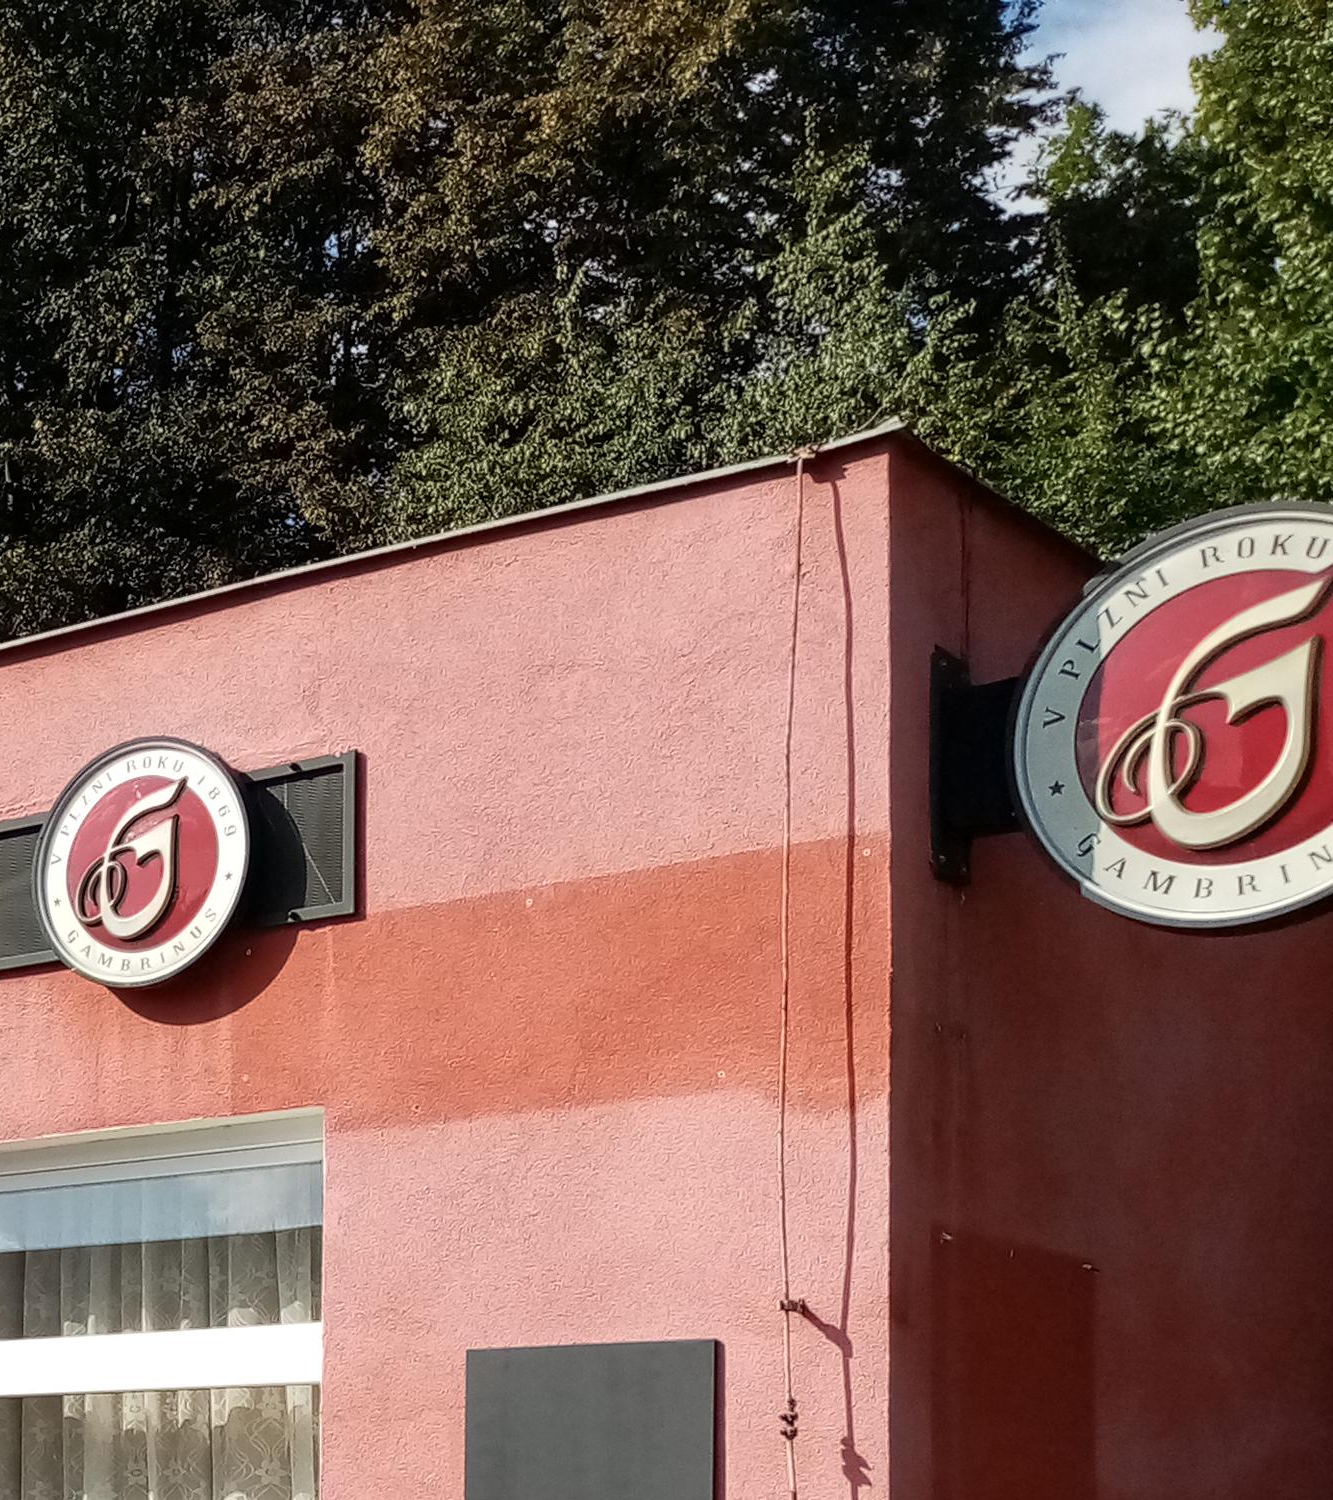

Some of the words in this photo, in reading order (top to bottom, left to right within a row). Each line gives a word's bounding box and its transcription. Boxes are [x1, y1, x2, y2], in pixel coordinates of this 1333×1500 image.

[1043, 706, 1067, 729] V
[1200, 533, 1331, 569] ROKU
[125, 755, 186, 774] ROKU
[197, 774, 238, 838] 1869
[66, 907, 218, 972] GAMBRINUS
